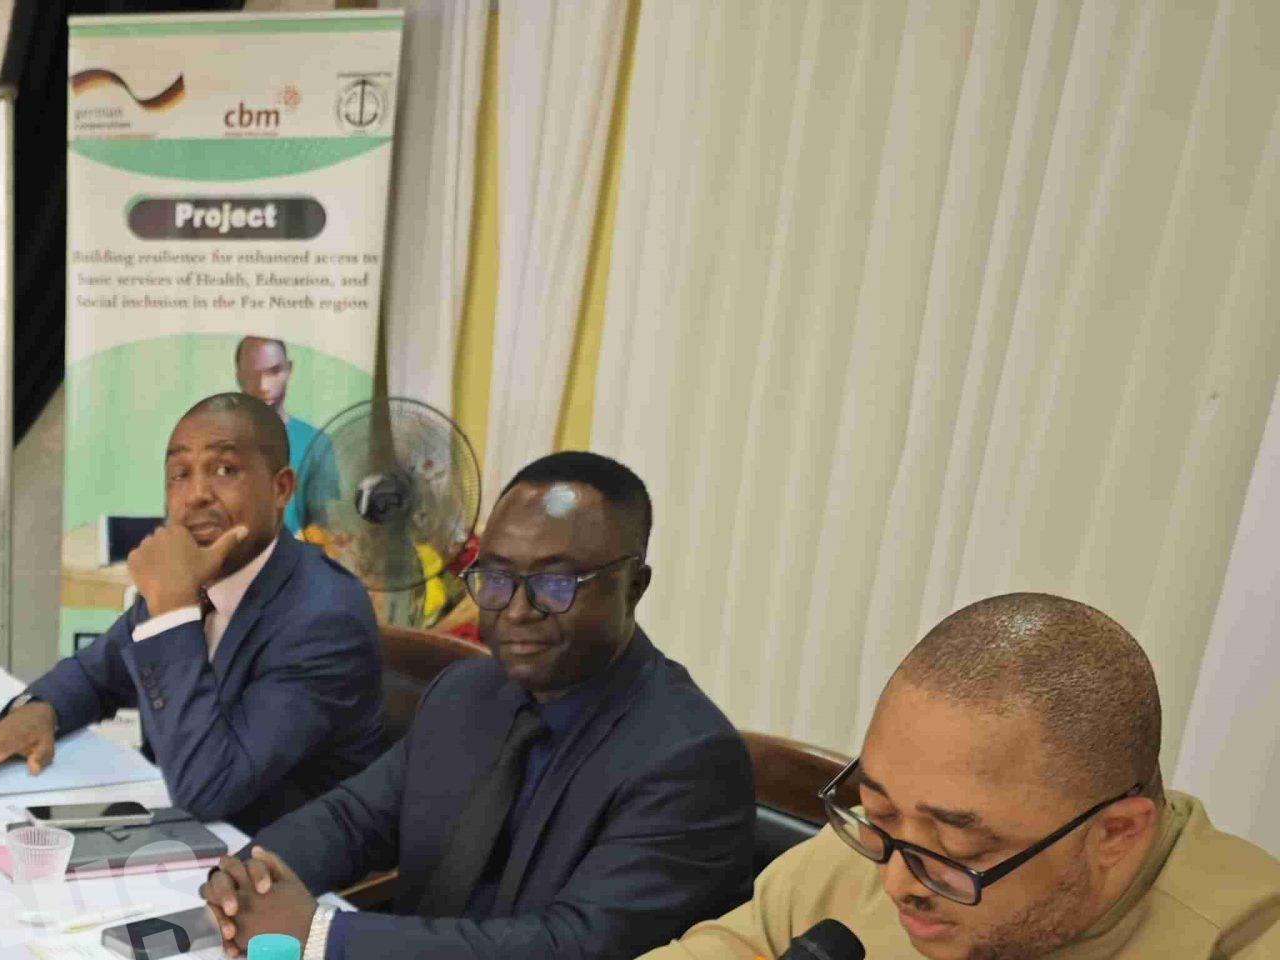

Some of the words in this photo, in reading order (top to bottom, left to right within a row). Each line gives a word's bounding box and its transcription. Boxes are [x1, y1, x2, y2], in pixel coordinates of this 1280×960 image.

[224, 100, 280, 128] cbm
[174, 202, 278, 234] Project
[211, 249, 233, 263] for
[237, 250, 309, 264] enhanced
[117, 272, 172, 286] services
[176, 272, 195, 286] of
[340, 272, 369, 287] and
[122, 295, 188, 309] inclusion
[193, 295, 209, 309] in
[269, 295, 315, 309] North
